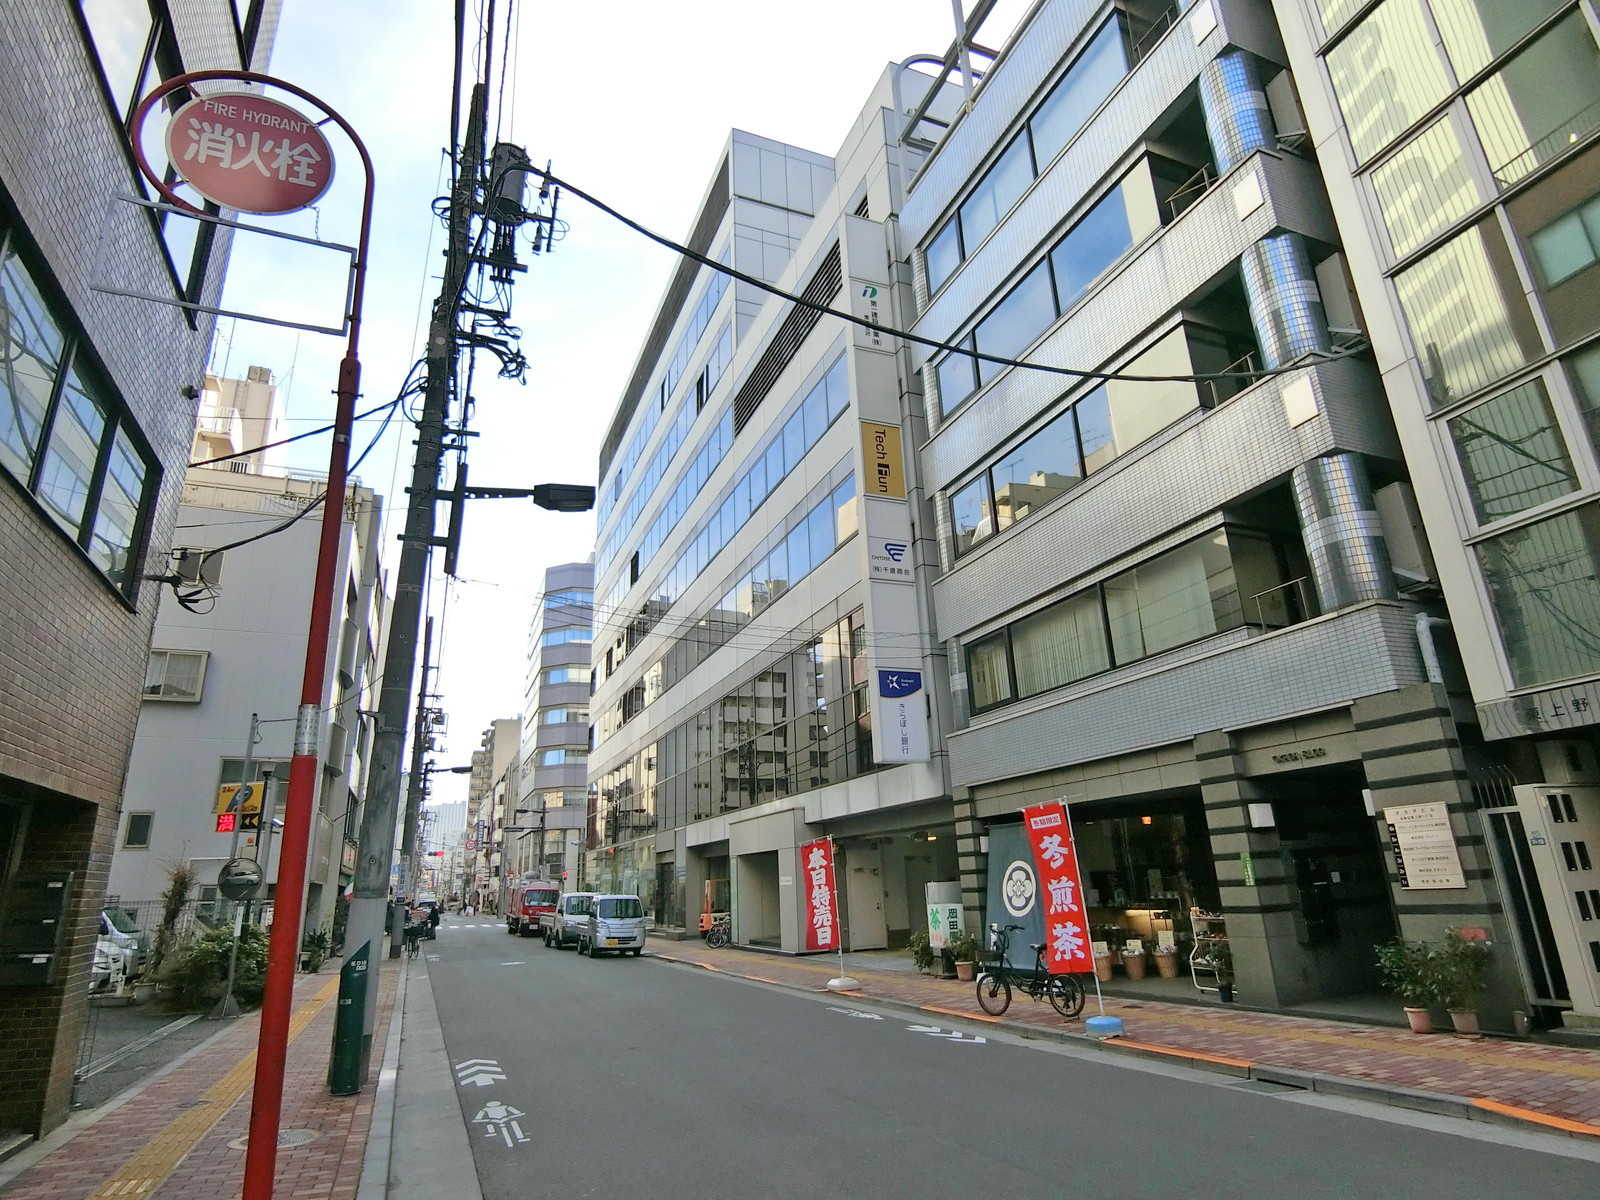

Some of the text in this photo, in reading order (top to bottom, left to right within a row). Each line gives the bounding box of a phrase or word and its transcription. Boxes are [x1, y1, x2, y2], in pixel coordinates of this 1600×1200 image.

[204, 100, 310, 134] FIRE HYDRANT
[183, 117, 321, 187] 消火栓
[875, 429, 887, 460] Tech
[899, 703, 909, 755] きらぼし銀行
[1032, 815, 1060, 827] 冬期限定
[807, 847, 832, 946] 本日特売日
[1038, 833, 1086, 962] 冬煎茶
[929, 908, 941, 930] 茶
